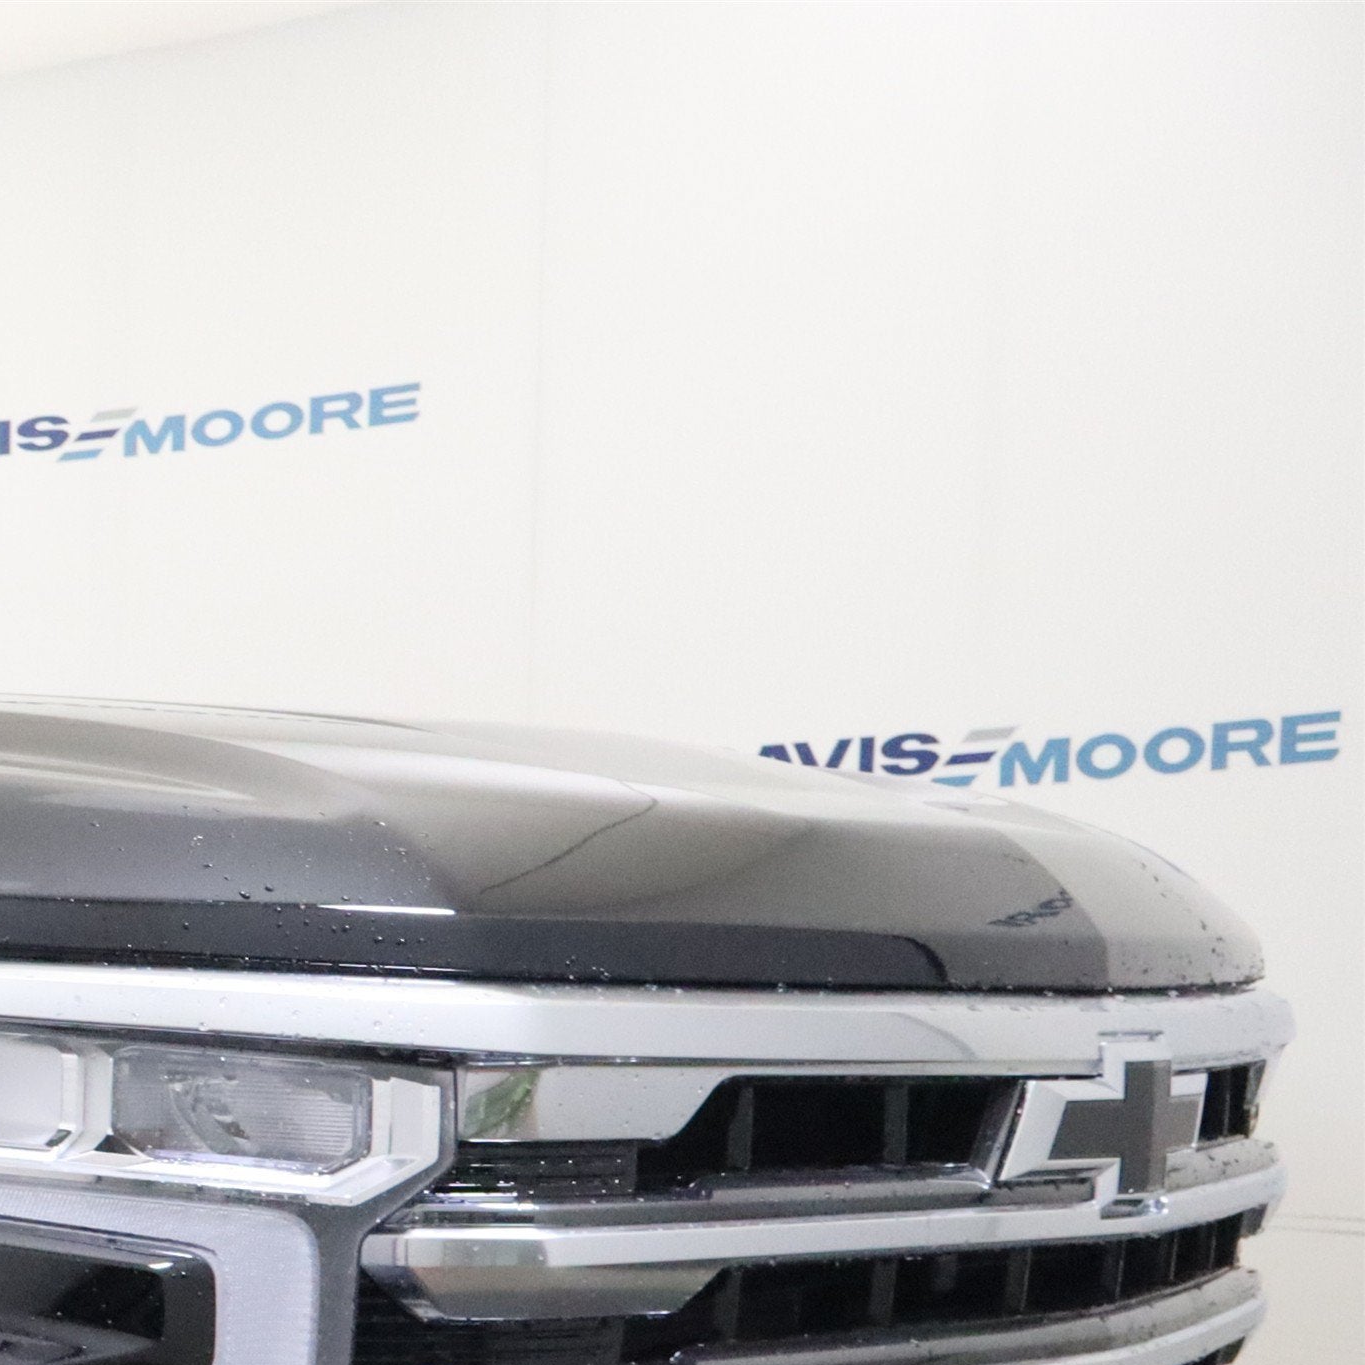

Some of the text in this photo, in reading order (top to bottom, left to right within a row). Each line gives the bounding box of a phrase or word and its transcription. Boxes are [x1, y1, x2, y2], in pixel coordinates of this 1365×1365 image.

[122, 381, 421, 457] MOORE
[758, 710, 1342, 787] VIS MOORE
